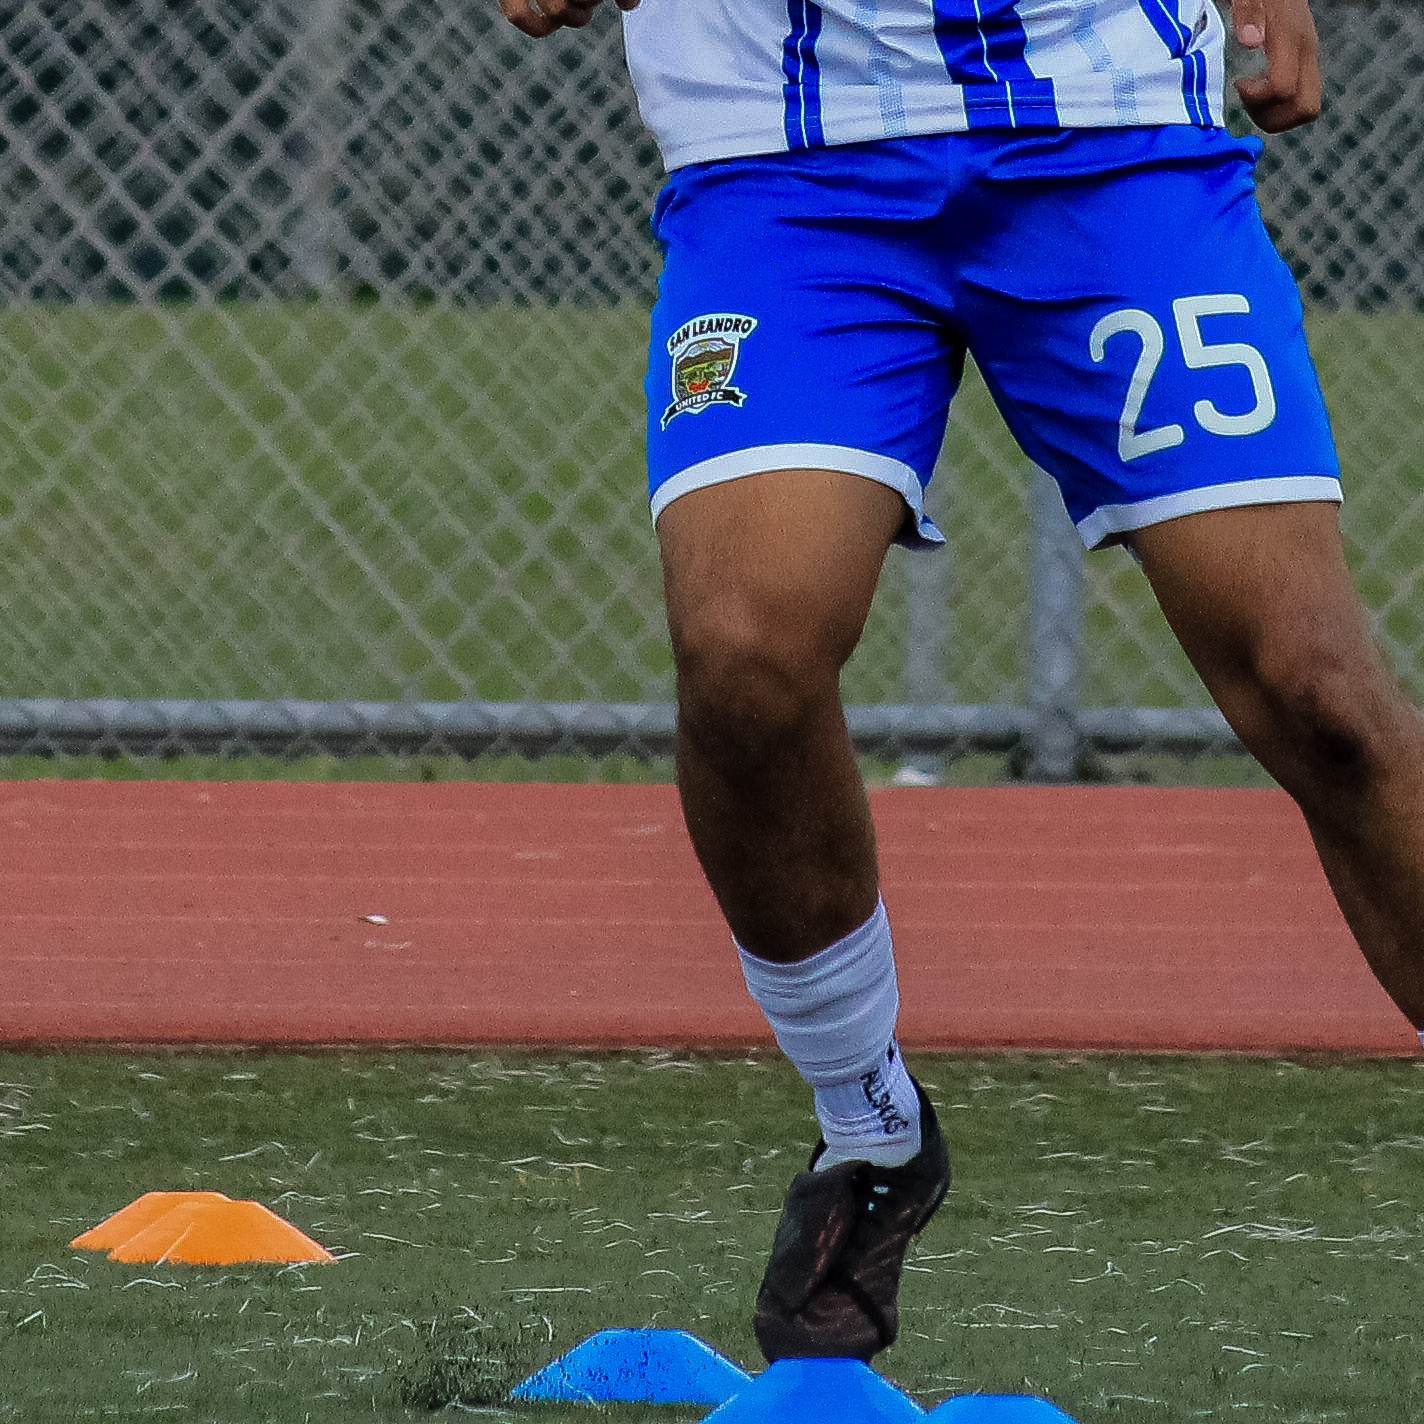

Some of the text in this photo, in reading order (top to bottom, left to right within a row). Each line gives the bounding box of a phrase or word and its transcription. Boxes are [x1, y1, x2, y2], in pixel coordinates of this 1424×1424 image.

[669, 317, 753, 352] SAN LEANDRO
[1088, 293, 1277, 462] 25
[674, 391, 724, 411] UNITED FC
